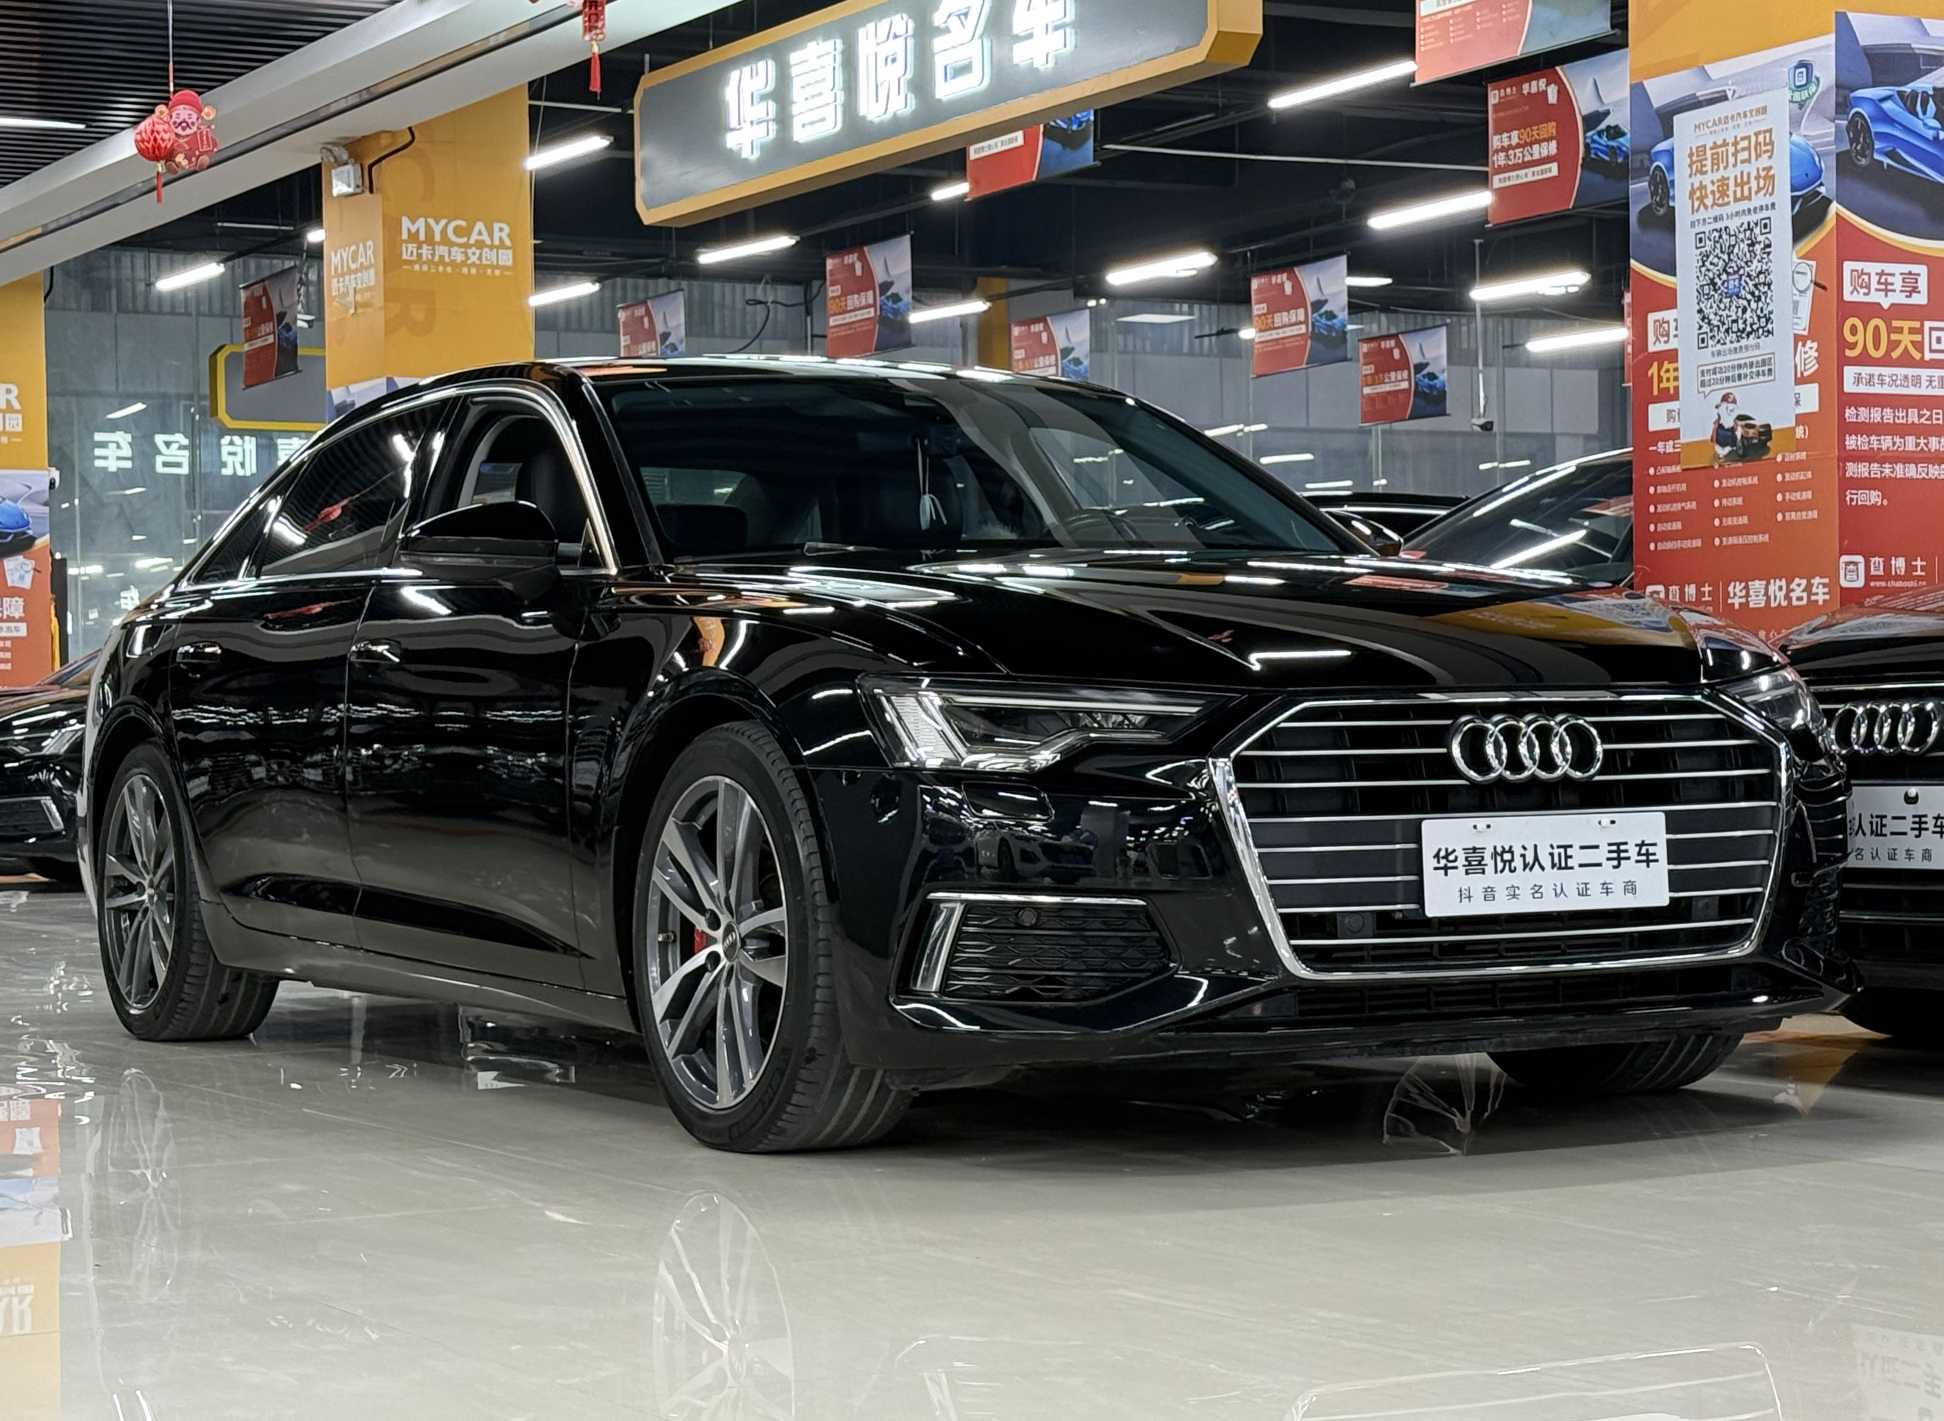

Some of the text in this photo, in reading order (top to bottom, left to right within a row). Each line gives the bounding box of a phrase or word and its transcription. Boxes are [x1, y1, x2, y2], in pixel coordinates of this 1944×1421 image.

[725, 0, 1077, 159] 华喜悦名车
[1688, 127, 1775, 178] 提前扫码
[1689, 165, 1776, 215] 快速出场
[401, 215, 513, 247] MYCAR
[331, 240, 375, 276] MYCAR
[401, 243, 513, 267] 迈卡汽车文创园
[1849, 268, 1922, 299] 购车享
[1653, 318, 1679, 345] 购
[1843, 316, 1944, 360] 90天回
[1795, 340, 1819, 378] 修
[1852, 372, 1922, 389] 承诺车况透明
[1845, 406, 1943, 424] 检测报告出具之日
[1869, 557, 1927, 576] 查博士
[1727, 576, 1830, 609] 华喜悦名车
[1432, 840, 1659, 876] 华喜悦认证二手车
[1458, 880, 1638, 903] 抖音实名认证车商
